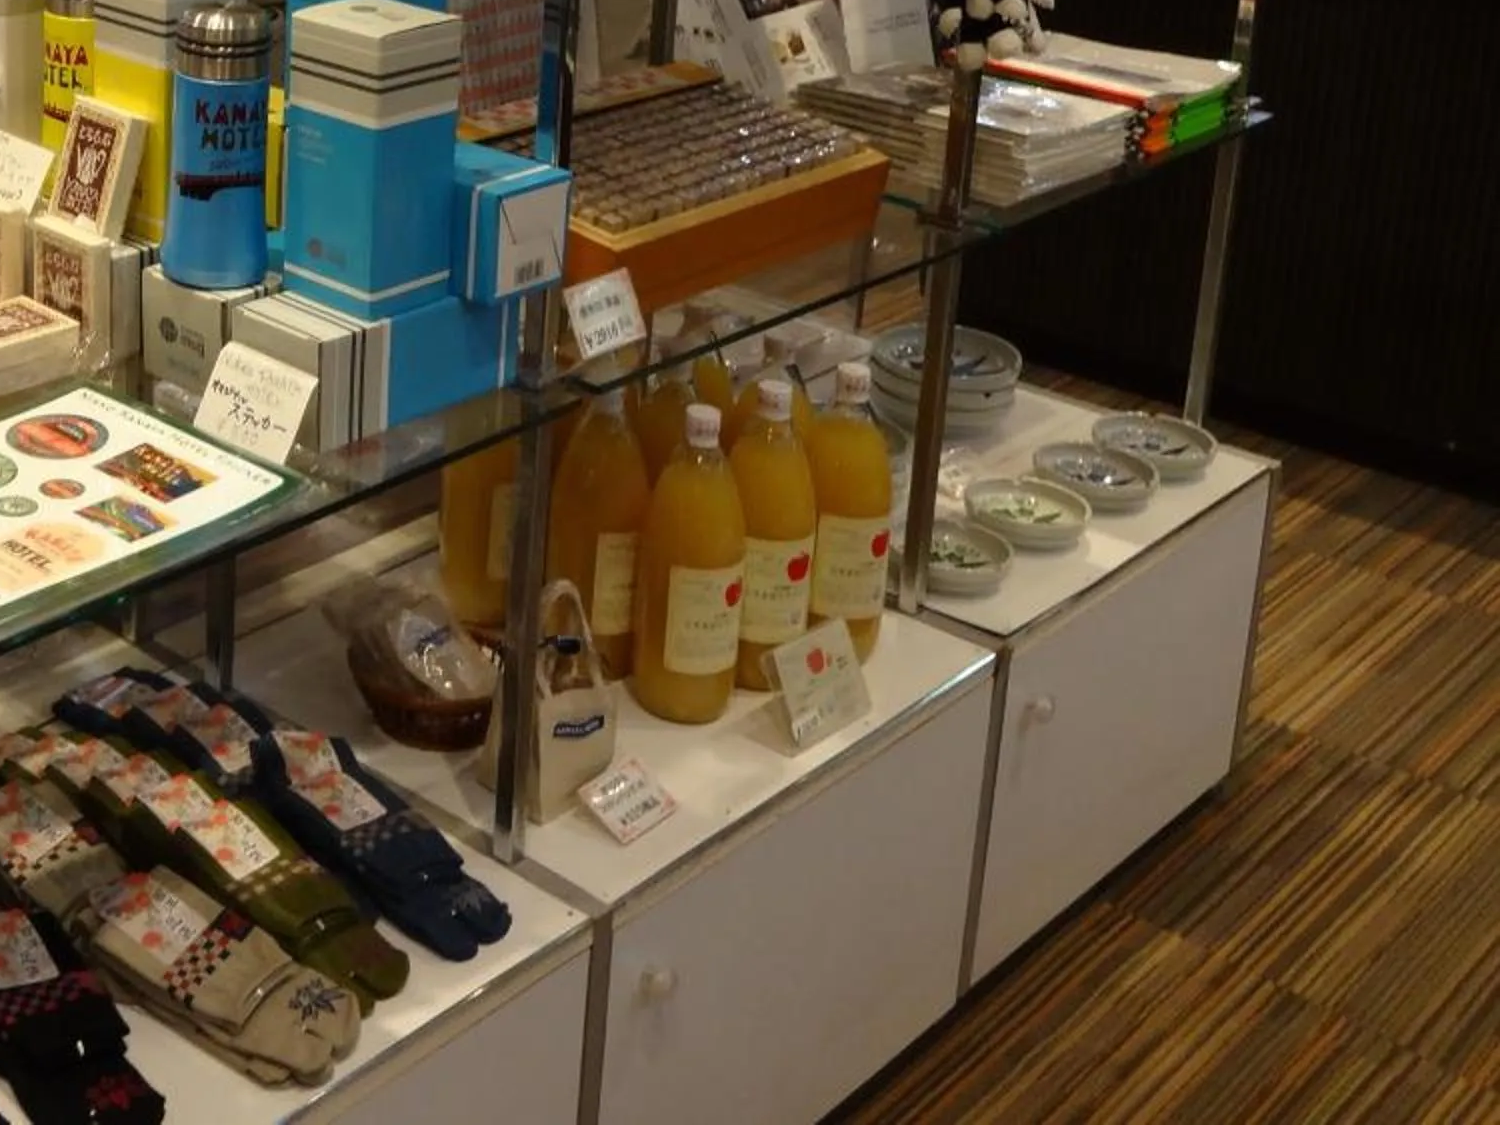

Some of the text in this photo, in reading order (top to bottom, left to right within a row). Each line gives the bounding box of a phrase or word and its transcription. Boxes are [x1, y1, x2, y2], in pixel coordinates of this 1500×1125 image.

[228, 402, 288, 433] ステッカー
